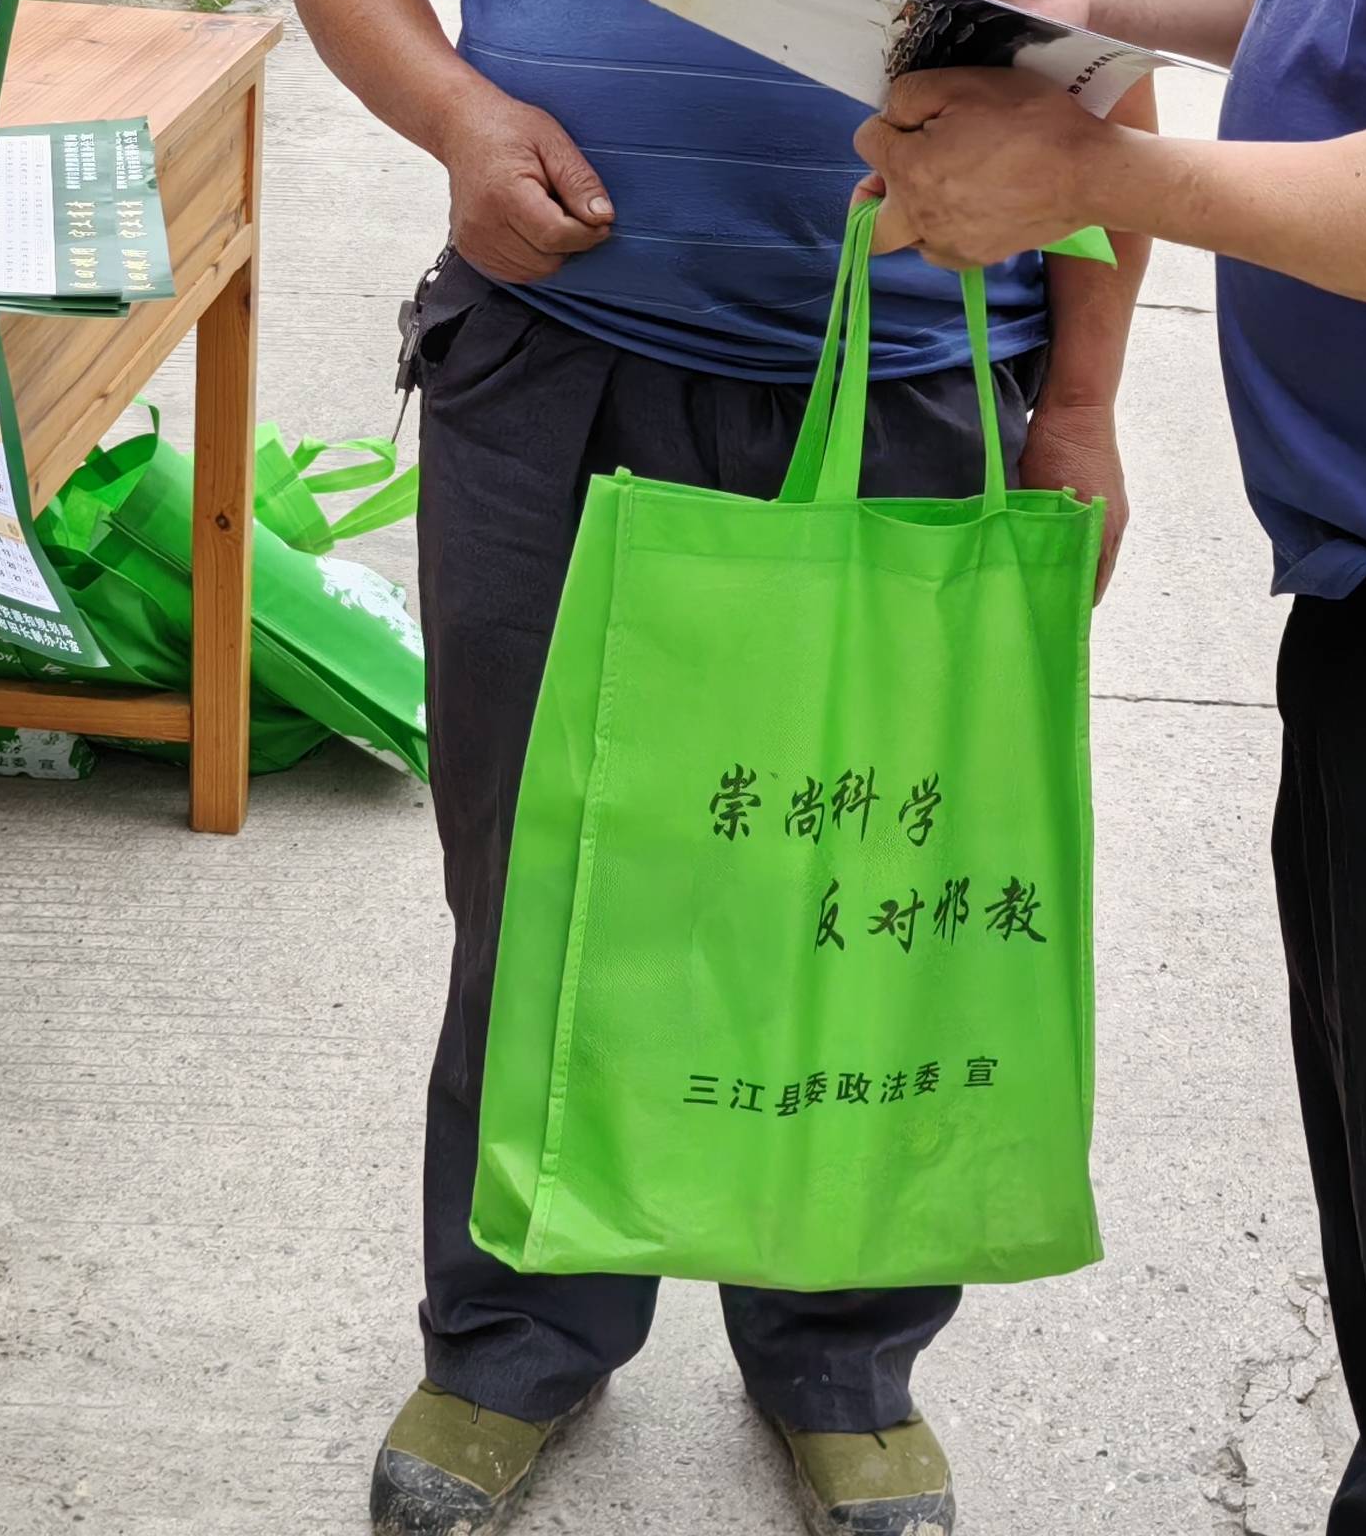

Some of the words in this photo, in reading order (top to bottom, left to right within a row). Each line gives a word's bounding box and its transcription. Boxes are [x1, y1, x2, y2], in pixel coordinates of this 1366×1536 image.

[709, 763, 942, 847] 崇尚科学
[814, 876, 1047, 955] 反对邪教
[683, 1056, 999, 1117] 三江县委政法委宣
